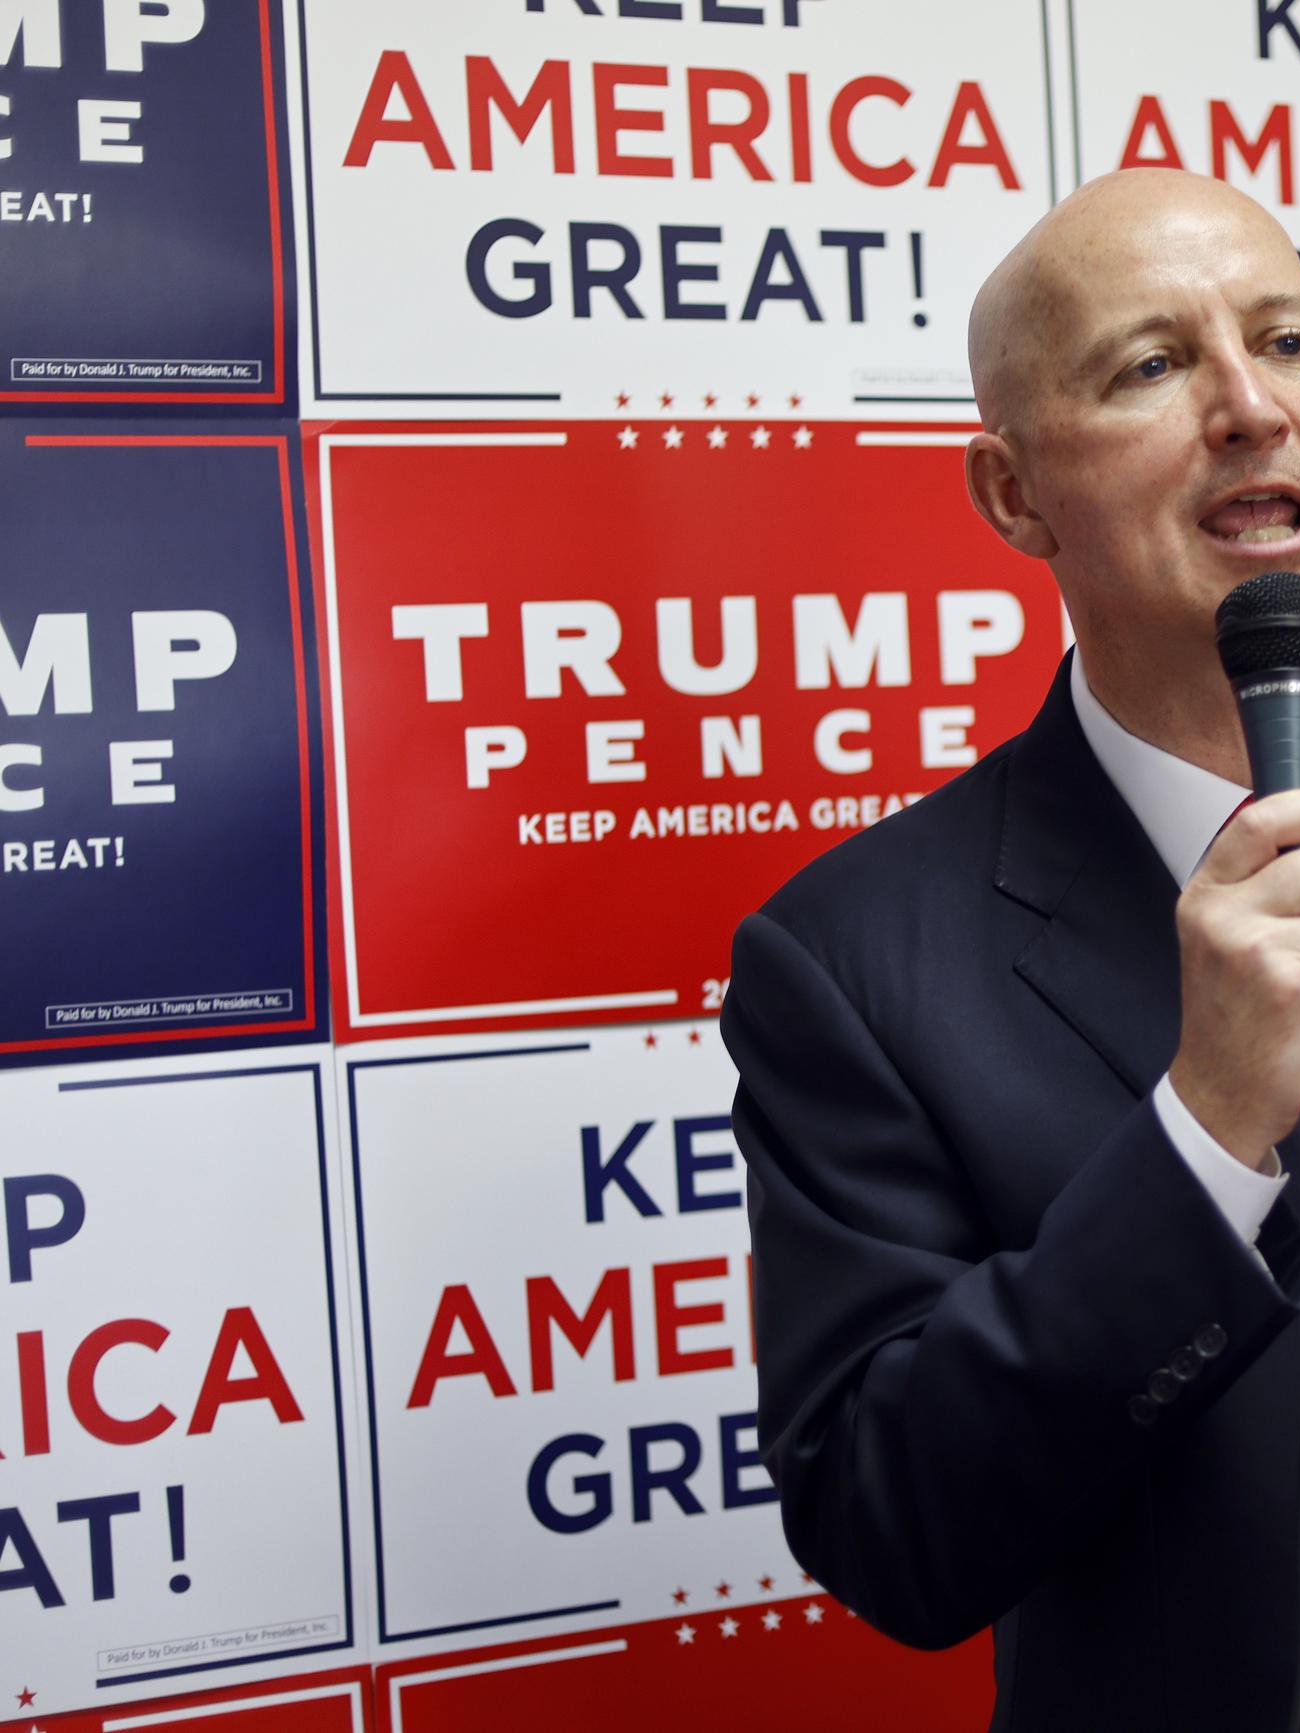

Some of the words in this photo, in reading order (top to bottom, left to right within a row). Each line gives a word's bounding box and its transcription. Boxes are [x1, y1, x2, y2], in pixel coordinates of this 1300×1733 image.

[342, 49, 1023, 191] AMERICA
[465, 217, 930, 329] GREAT!
[22, 363, 44, 375] Paid
[47, 362, 62, 375] for
[64, 363, 77, 377] by
[79, 363, 116, 376] Donald
[118, 364, 126, 376] J.
[129, 364, 162, 378] Trump
[164, 363, 178, 376] for
[181, 364, 231, 378] President,
[233, 365, 251, 377] Inc.
[391, 589, 1025, 702] TRUMP
[464, 706, 977, 790] PENCE
[519, 810, 616, 845] KEEP
[630, 799, 800, 840] AMERICA
[809, 792, 932, 830] GREA
[56, 1009, 79, 1022] Paid
[81, 1007, 96, 1021] for
[98, 1007, 111, 1022] by
[113, 1004, 150, 1019] Donald
[162, 1001, 195, 1016] Trump
[197, 1000, 211, 1012] for
[214, 996, 263, 1010] President,
[265, 995, 282, 1006] Inc.
[580, 1113, 743, 1225] KE
[0, 1306, 305, 1460] ICA
[526, 1411, 783, 1535] GRE
[107, 1649, 129, 1664] Paid
[131, 1646, 146, 1661] for
[149, 1645, 161, 1660] by
[163, 1640, 199, 1656] Donald
[211, 1634, 244, 1650] Trump
[245, 1631, 259, 1645] for
